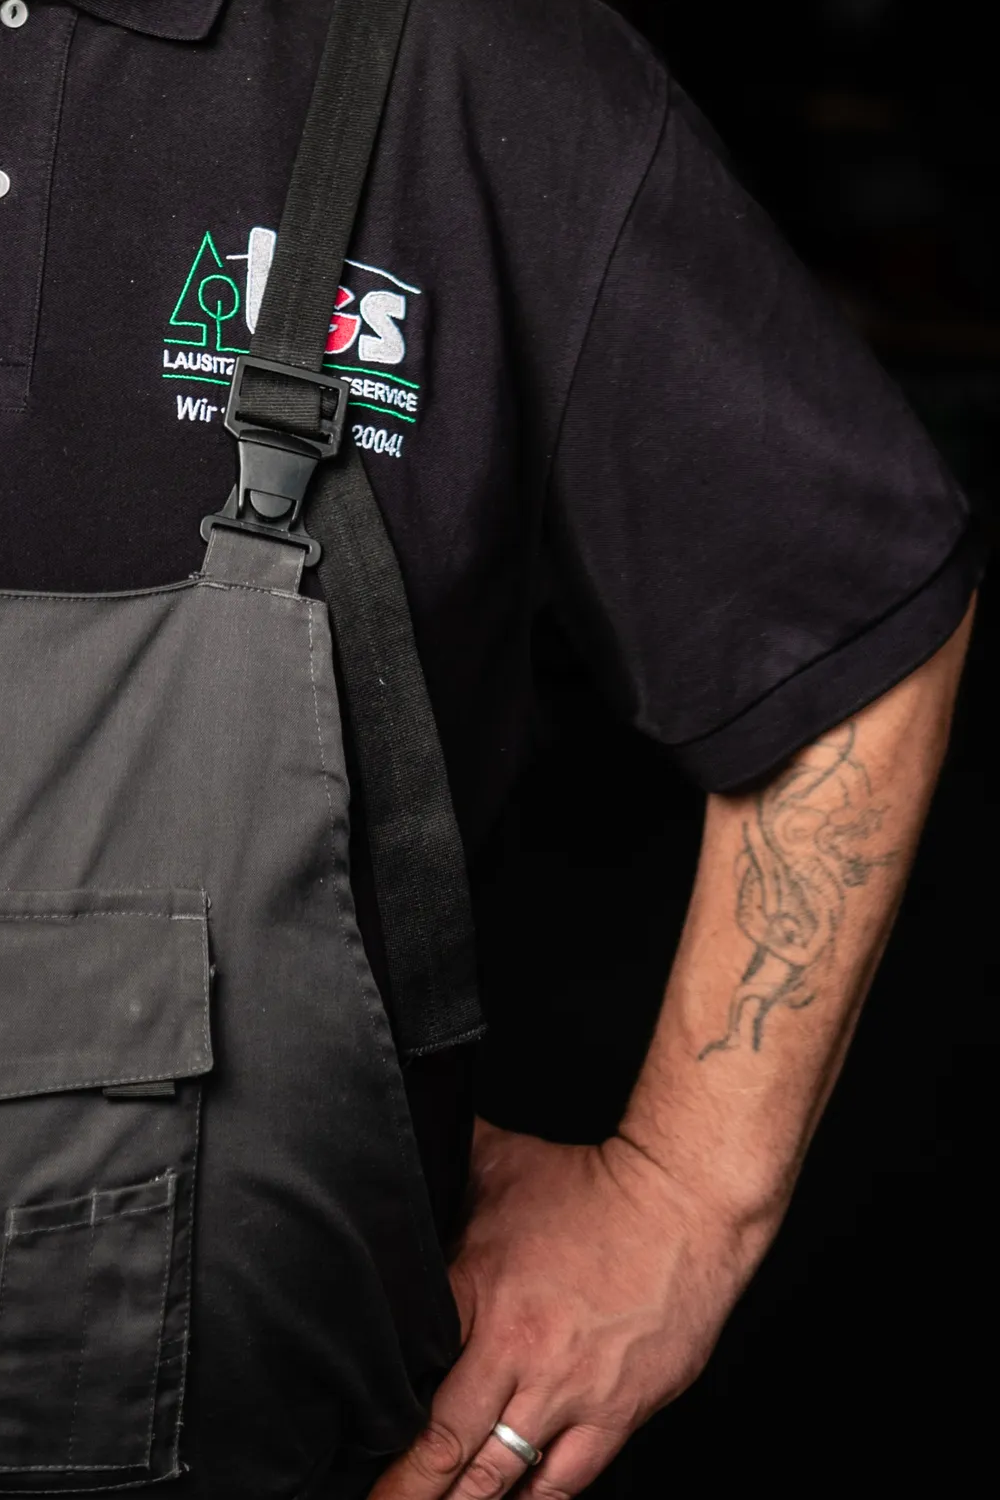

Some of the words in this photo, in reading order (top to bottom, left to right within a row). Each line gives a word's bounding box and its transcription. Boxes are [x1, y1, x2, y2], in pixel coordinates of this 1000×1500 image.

[340, 376, 418, 412] SERVICE
[176, 395, 218, 423] Wir
[352, 424, 404, 458] 2004!
